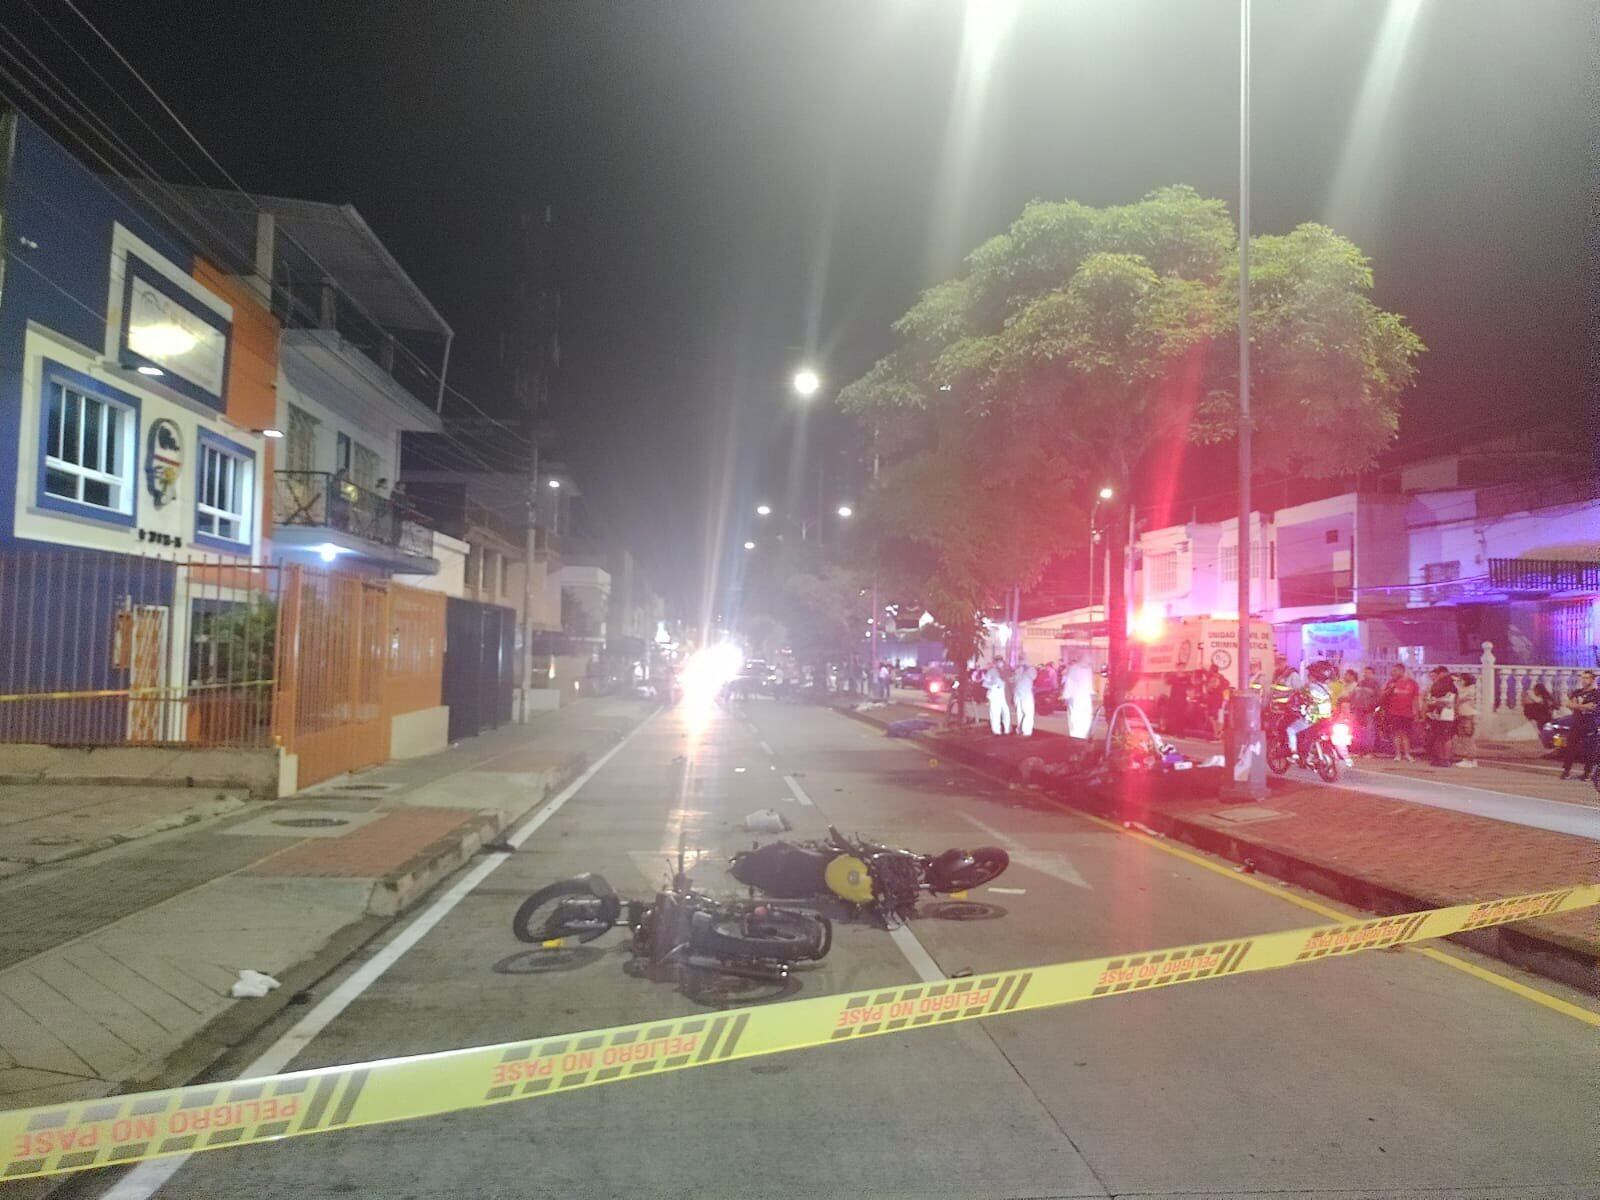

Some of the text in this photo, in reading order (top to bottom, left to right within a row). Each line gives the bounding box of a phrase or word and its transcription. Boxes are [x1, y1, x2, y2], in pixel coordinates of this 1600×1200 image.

[1098, 956, 1218, 985] PELIGRO NO PASE
[837, 990, 991, 1027] PELIGRO NO PASE
[493, 1035, 698, 1084] PELIGRO NO PASE
[14, 1096, 298, 1157] PELIGRO NO PASE
